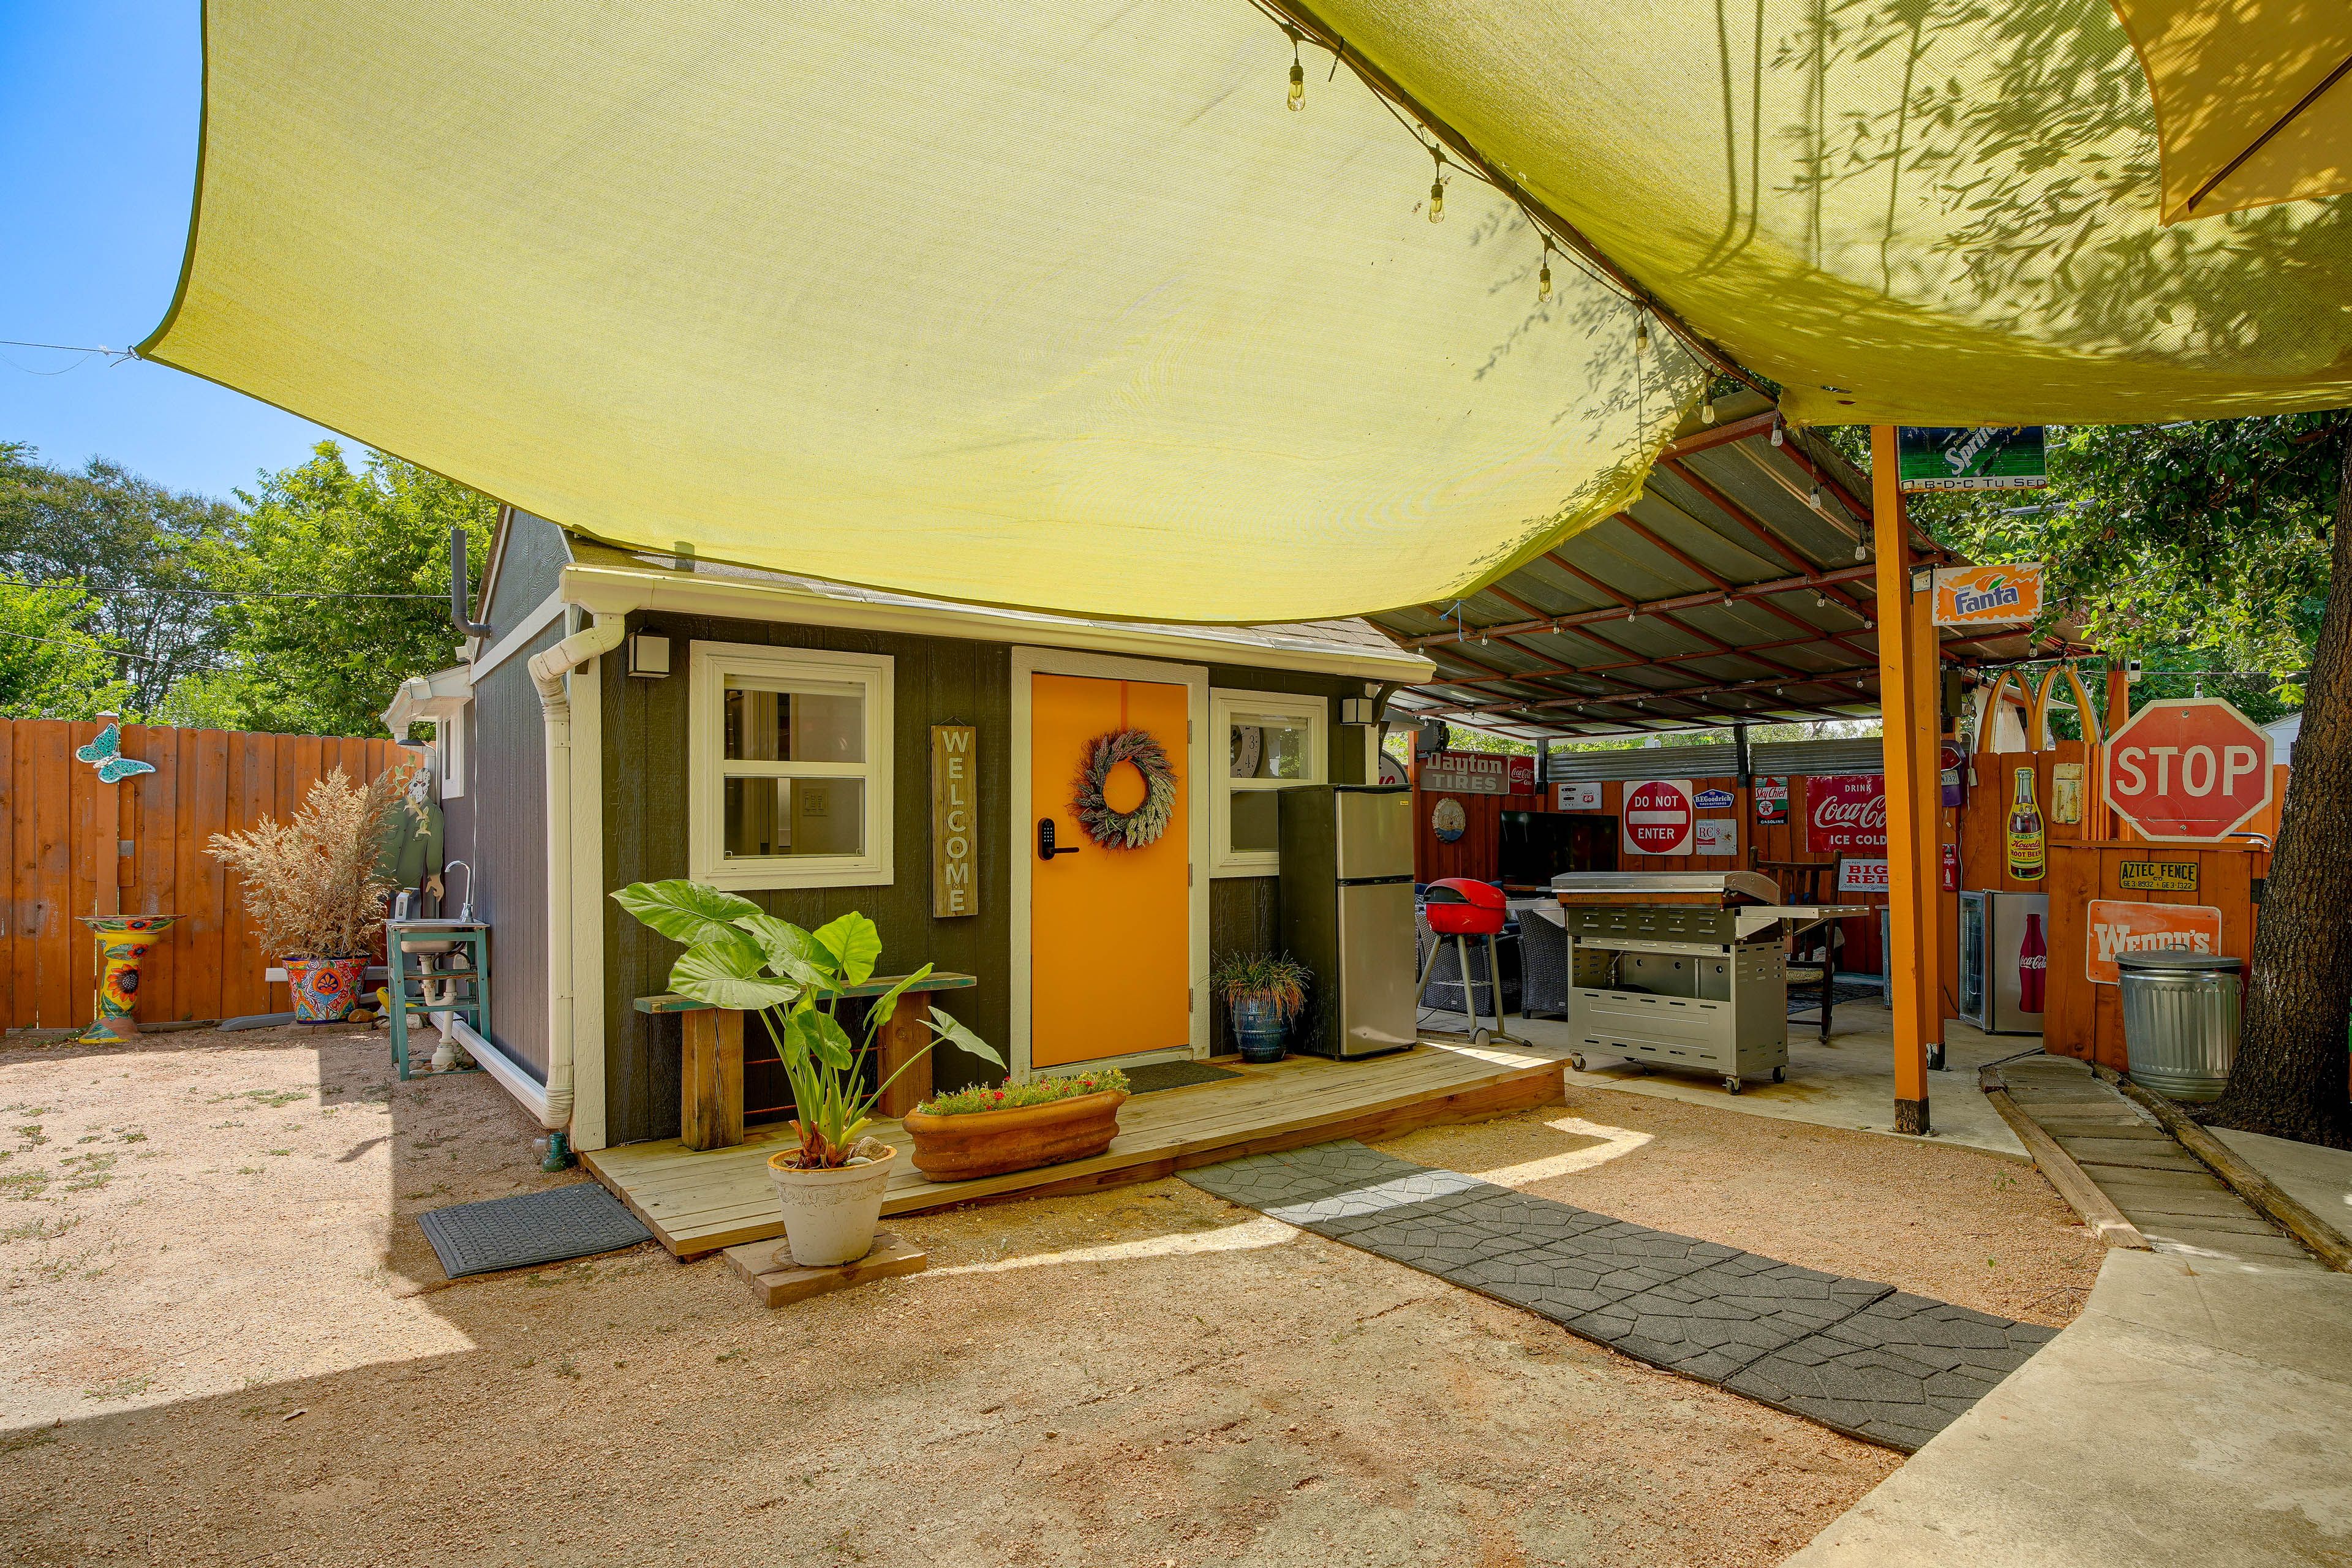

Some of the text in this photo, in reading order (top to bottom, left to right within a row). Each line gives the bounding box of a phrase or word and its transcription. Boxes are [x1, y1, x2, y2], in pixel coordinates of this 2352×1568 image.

[1955, 587, 2018, 615] Fanta
[1250, 735, 1254, 749] 3
[1245, 755, 1250, 767] 4
[1426, 752, 1502, 775] Dayton
[2116, 745, 2258, 797] STOP
[1432, 774, 1496, 791] TIRES
[1845, 784, 1872, 793] DRINK
[1756, 786, 1787, 800] Sky Chief
[1635, 796, 1678, 807] DO NOT
[1814, 795, 1887, 828] Coca-Co
[942, 731, 970, 911] WELCOME
[1638, 828, 1675, 839] ENTER
[1698, 827, 1714, 837] RC
[1831, 835, 1887, 845] ICE COLD
[1849, 865, 1888, 874] BIG
[2122, 864, 2195, 882] AZTEC FENCE
[2020, 956, 2046, 969] Coca-Cola
